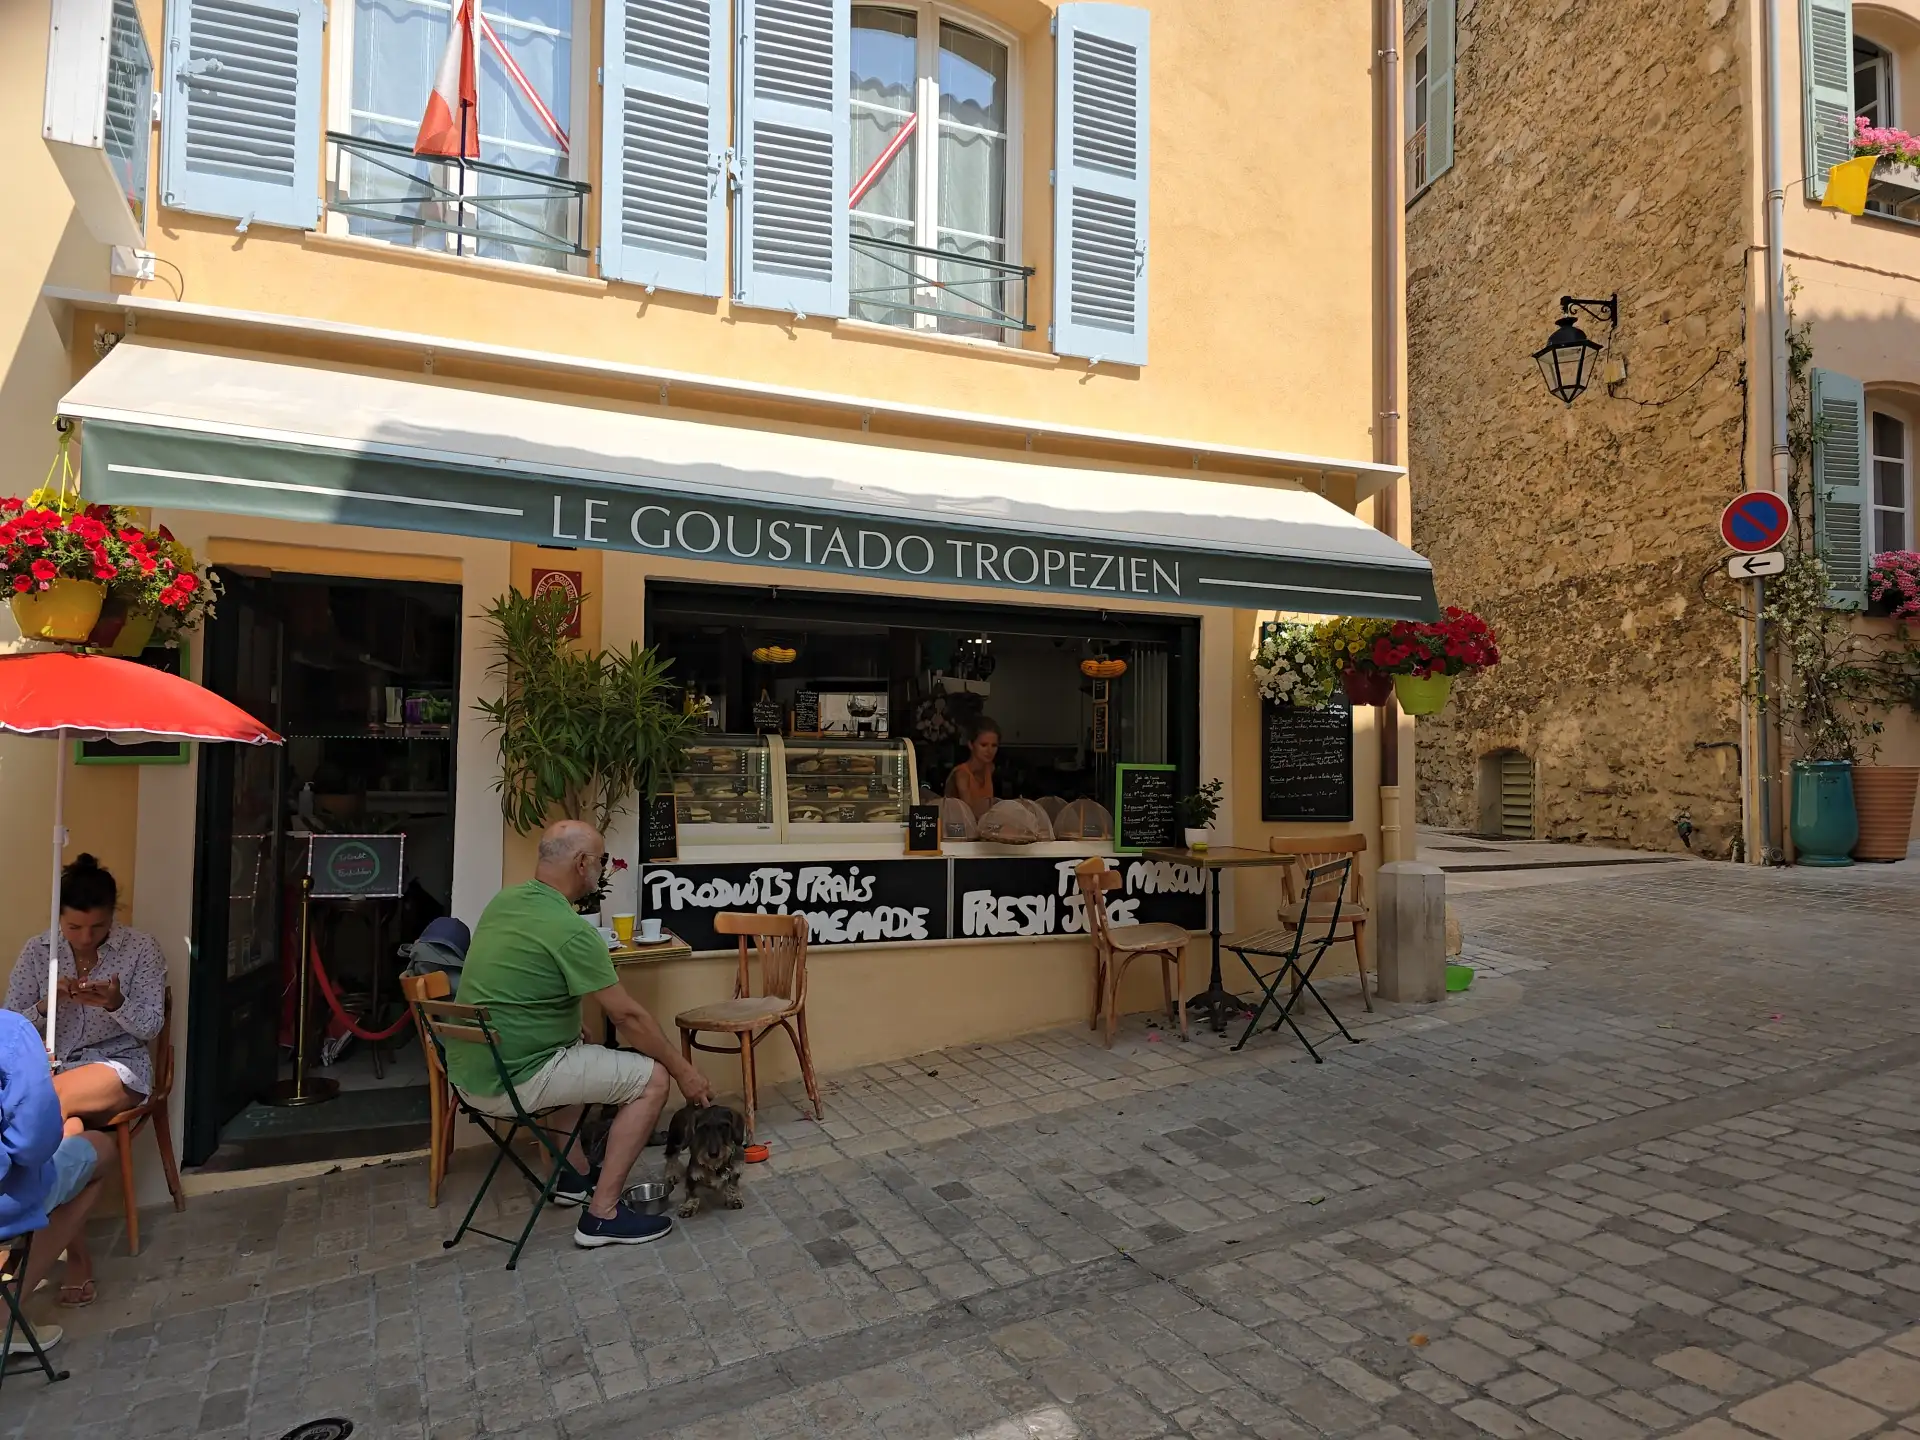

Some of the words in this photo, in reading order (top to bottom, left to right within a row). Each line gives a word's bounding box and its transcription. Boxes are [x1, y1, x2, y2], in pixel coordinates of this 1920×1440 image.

[552, 495, 609, 543] LE
[630, 505, 934, 575] GOUSTADO
[946, 539, 1181, 597] TROPEZIEN
[962, 889, 1055, 936] FRESH
